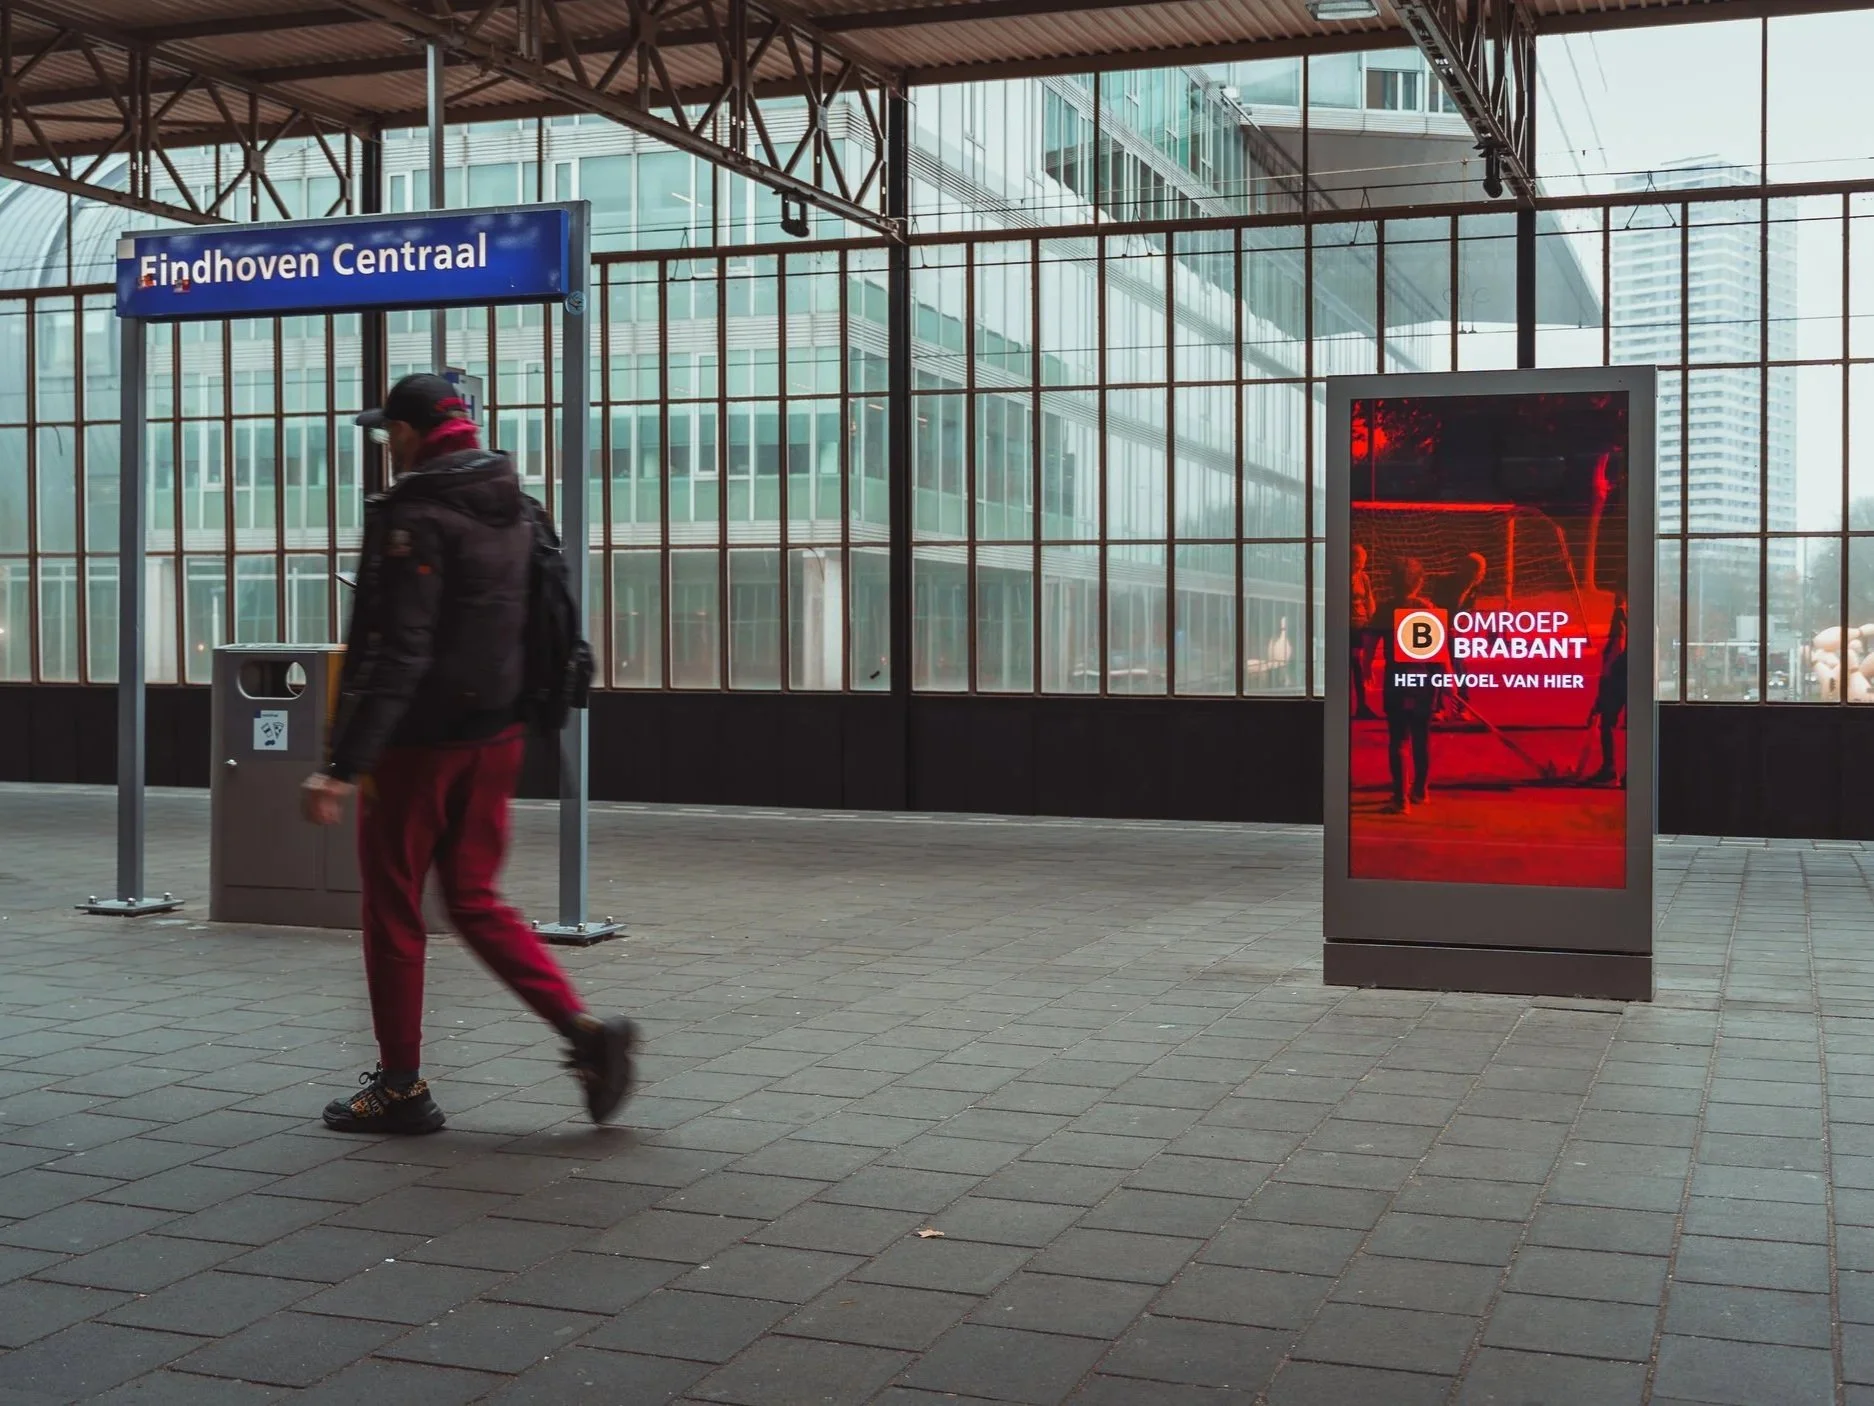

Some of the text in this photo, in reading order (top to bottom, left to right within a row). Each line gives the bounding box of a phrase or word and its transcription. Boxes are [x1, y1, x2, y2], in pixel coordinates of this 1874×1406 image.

[140, 232, 487, 288] Eindhoven Centraal
[1453, 611, 1569, 633] OMROEP
[1412, 622, 1433, 648] B
[1453, 637, 1587, 659] BRABANT
[1394, 673, 1585, 689] HET GEVOEL VAN HIER
